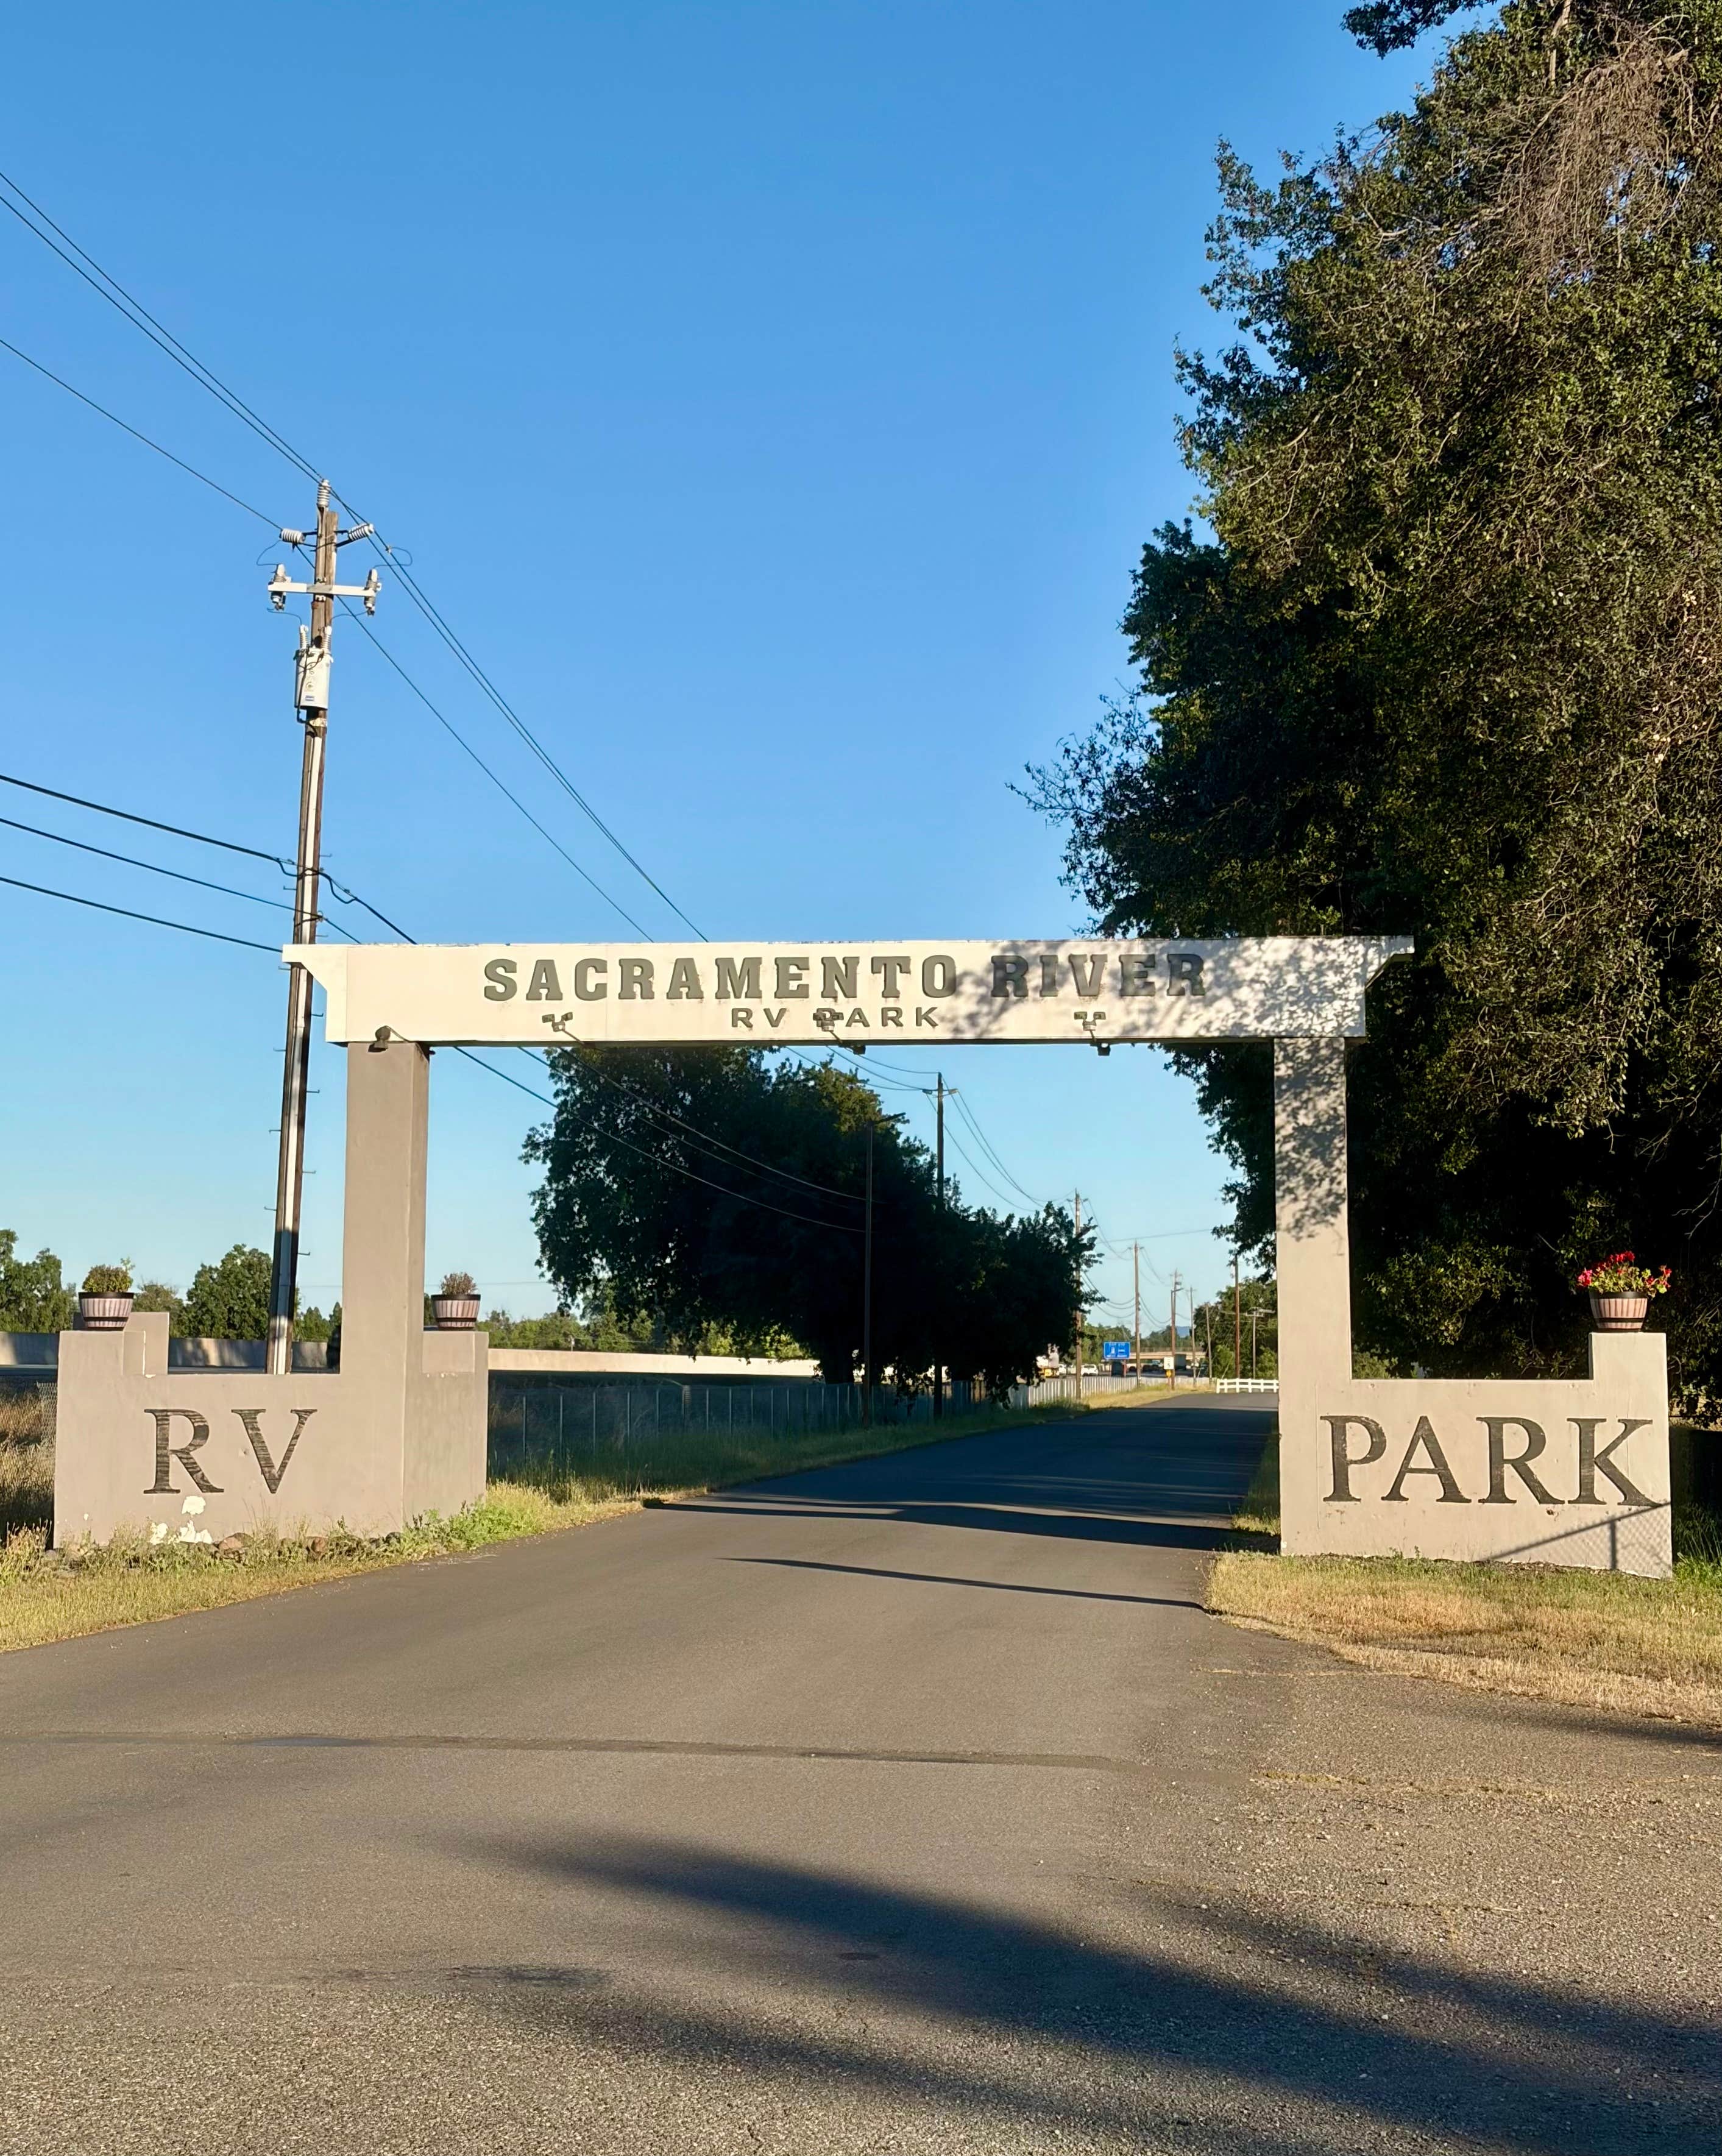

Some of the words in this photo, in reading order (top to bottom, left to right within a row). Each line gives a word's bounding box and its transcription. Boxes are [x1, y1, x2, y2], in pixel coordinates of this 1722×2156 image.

[484, 954, 957, 1001] SACRAMENTO
[990, 954, 1206, 998] RIVER
[731, 1007, 787, 1028] RV
[143, 1408, 317, 1494] RV
[1320, 1415, 1662, 1507] PARK
